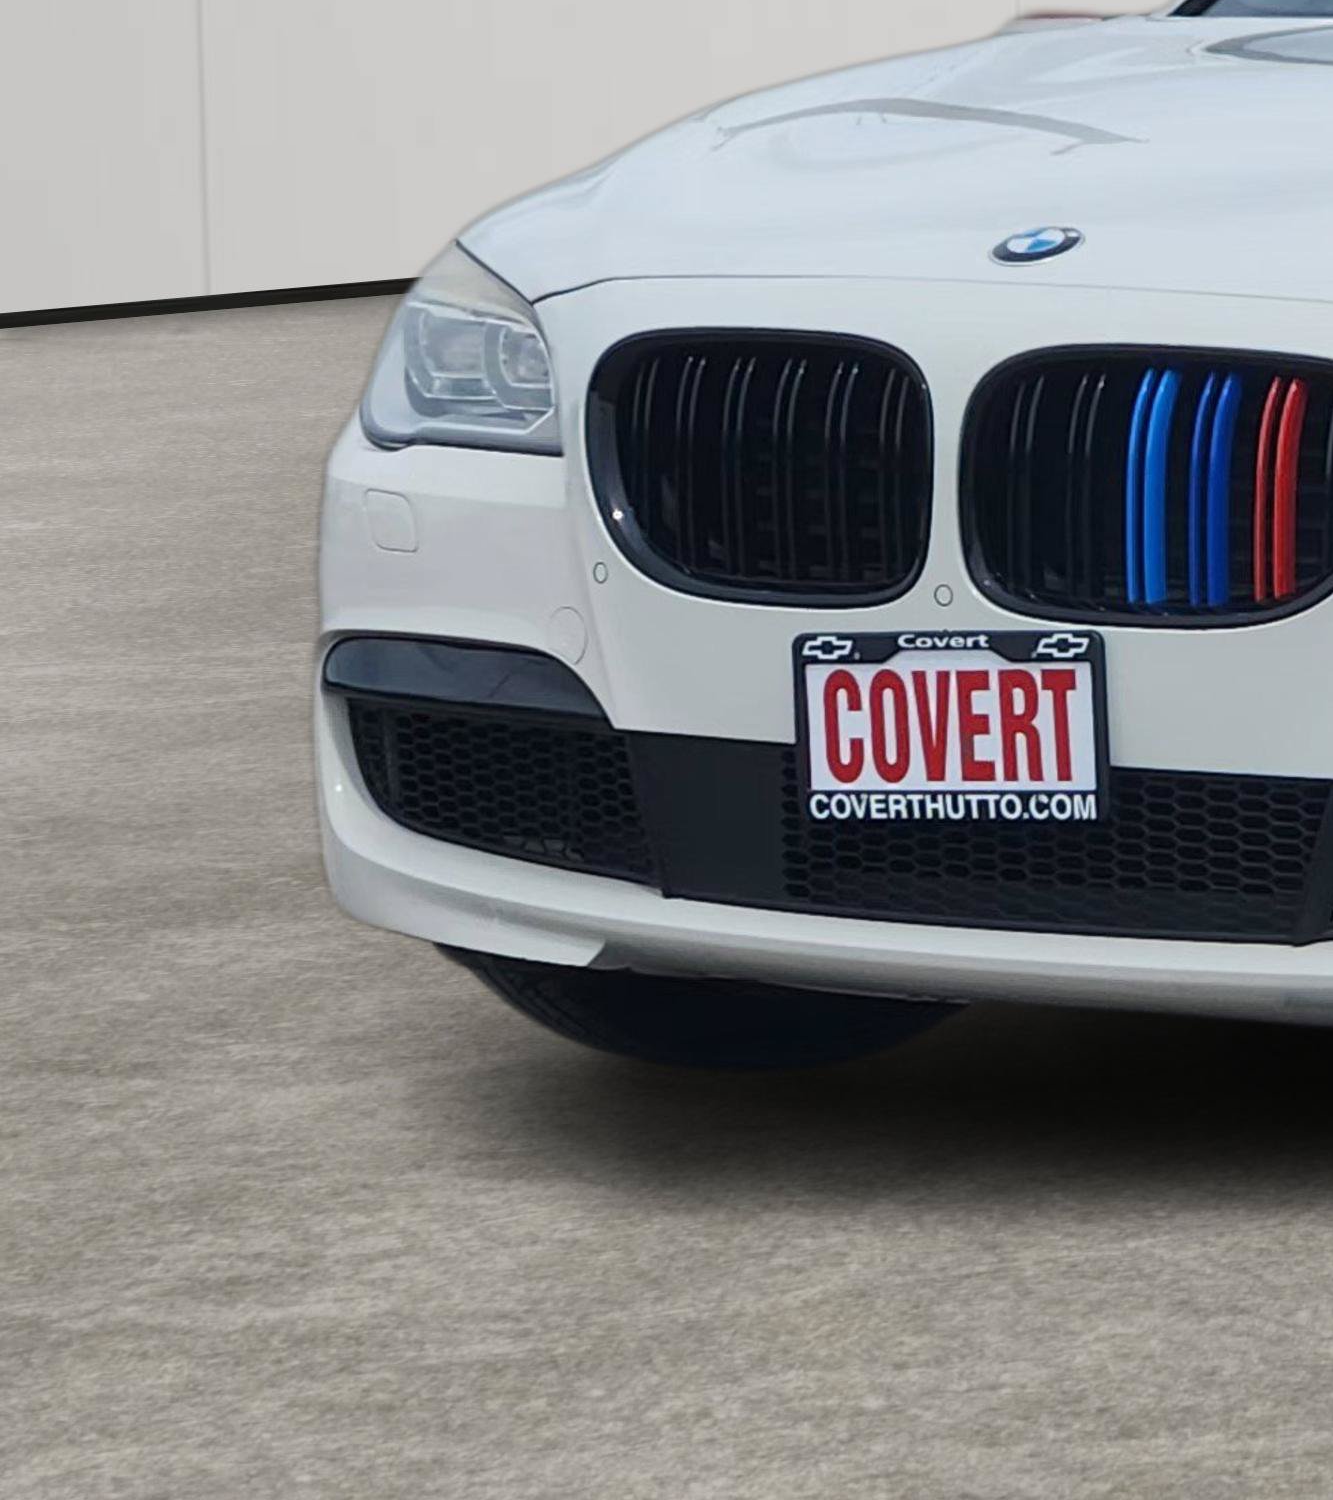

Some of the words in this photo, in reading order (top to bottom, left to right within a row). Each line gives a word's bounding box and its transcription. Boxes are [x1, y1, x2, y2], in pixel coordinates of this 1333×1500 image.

[897, 633, 990, 649] Covert
[823, 669, 1077, 783] COVERT
[809, 794, 1098, 821] COVERTHUTTO.COM
